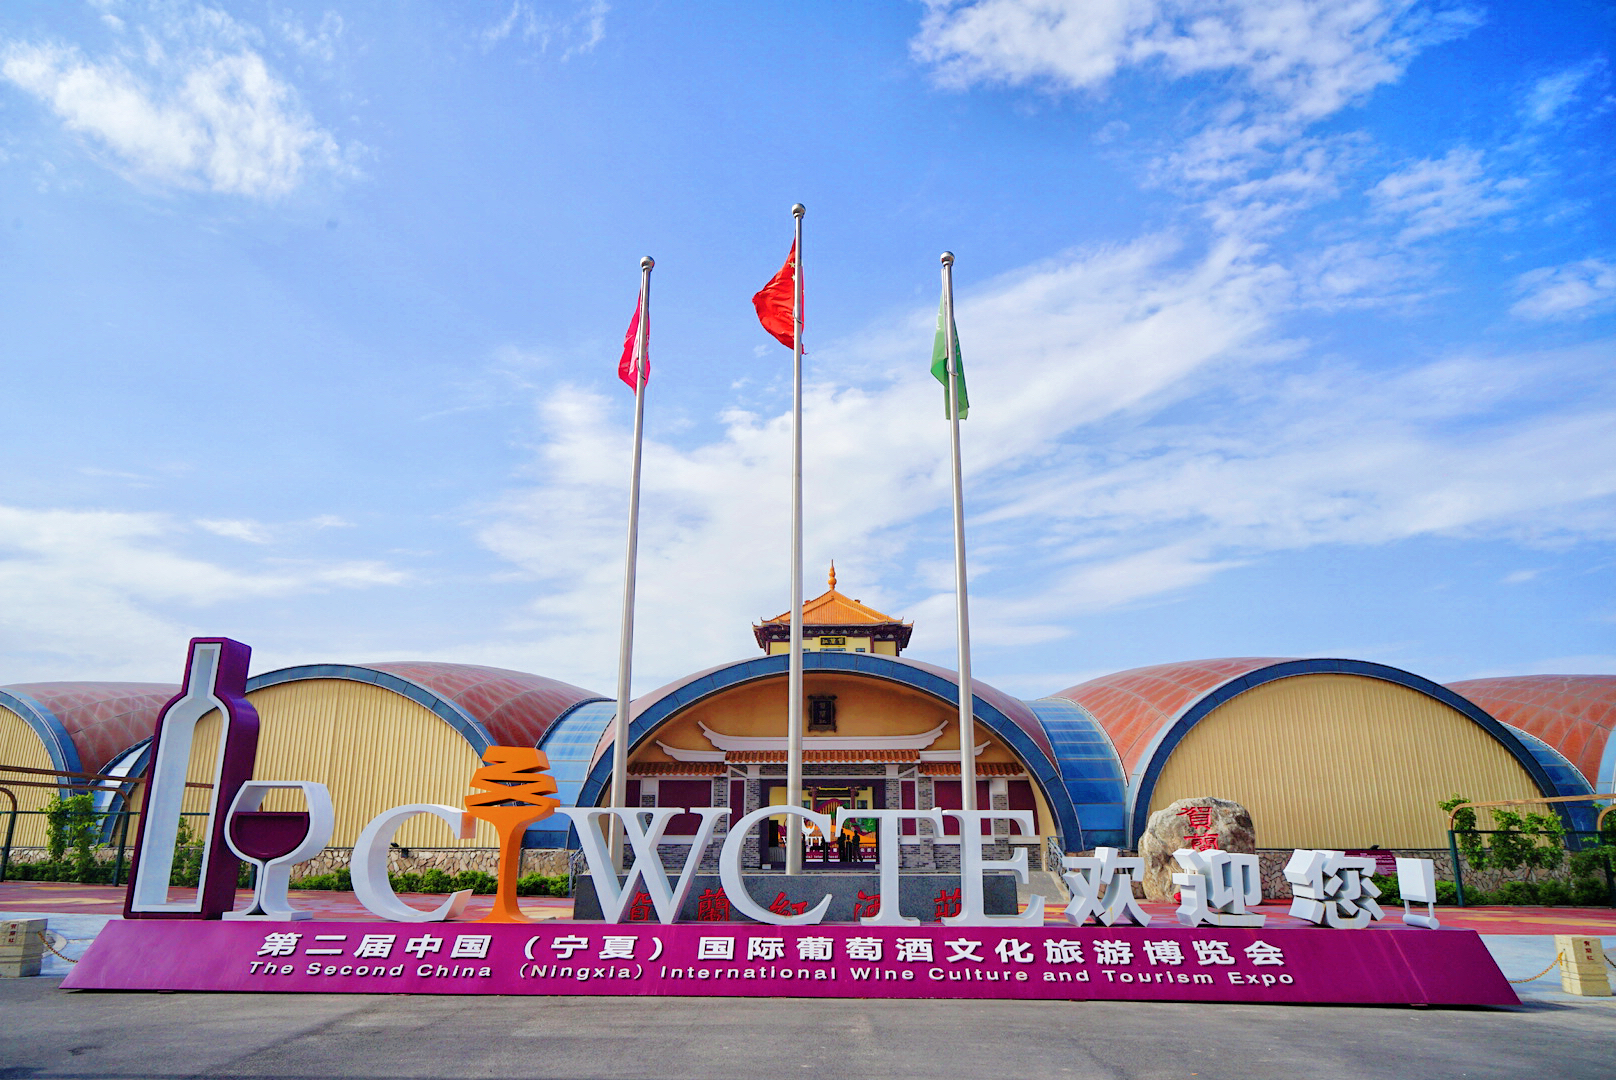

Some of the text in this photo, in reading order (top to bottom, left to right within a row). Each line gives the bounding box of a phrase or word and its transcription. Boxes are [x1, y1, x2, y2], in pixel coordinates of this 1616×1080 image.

[249, 961, 1294, 988] The Second China (Ningxia) International Wine Culture and Tourism Expo
